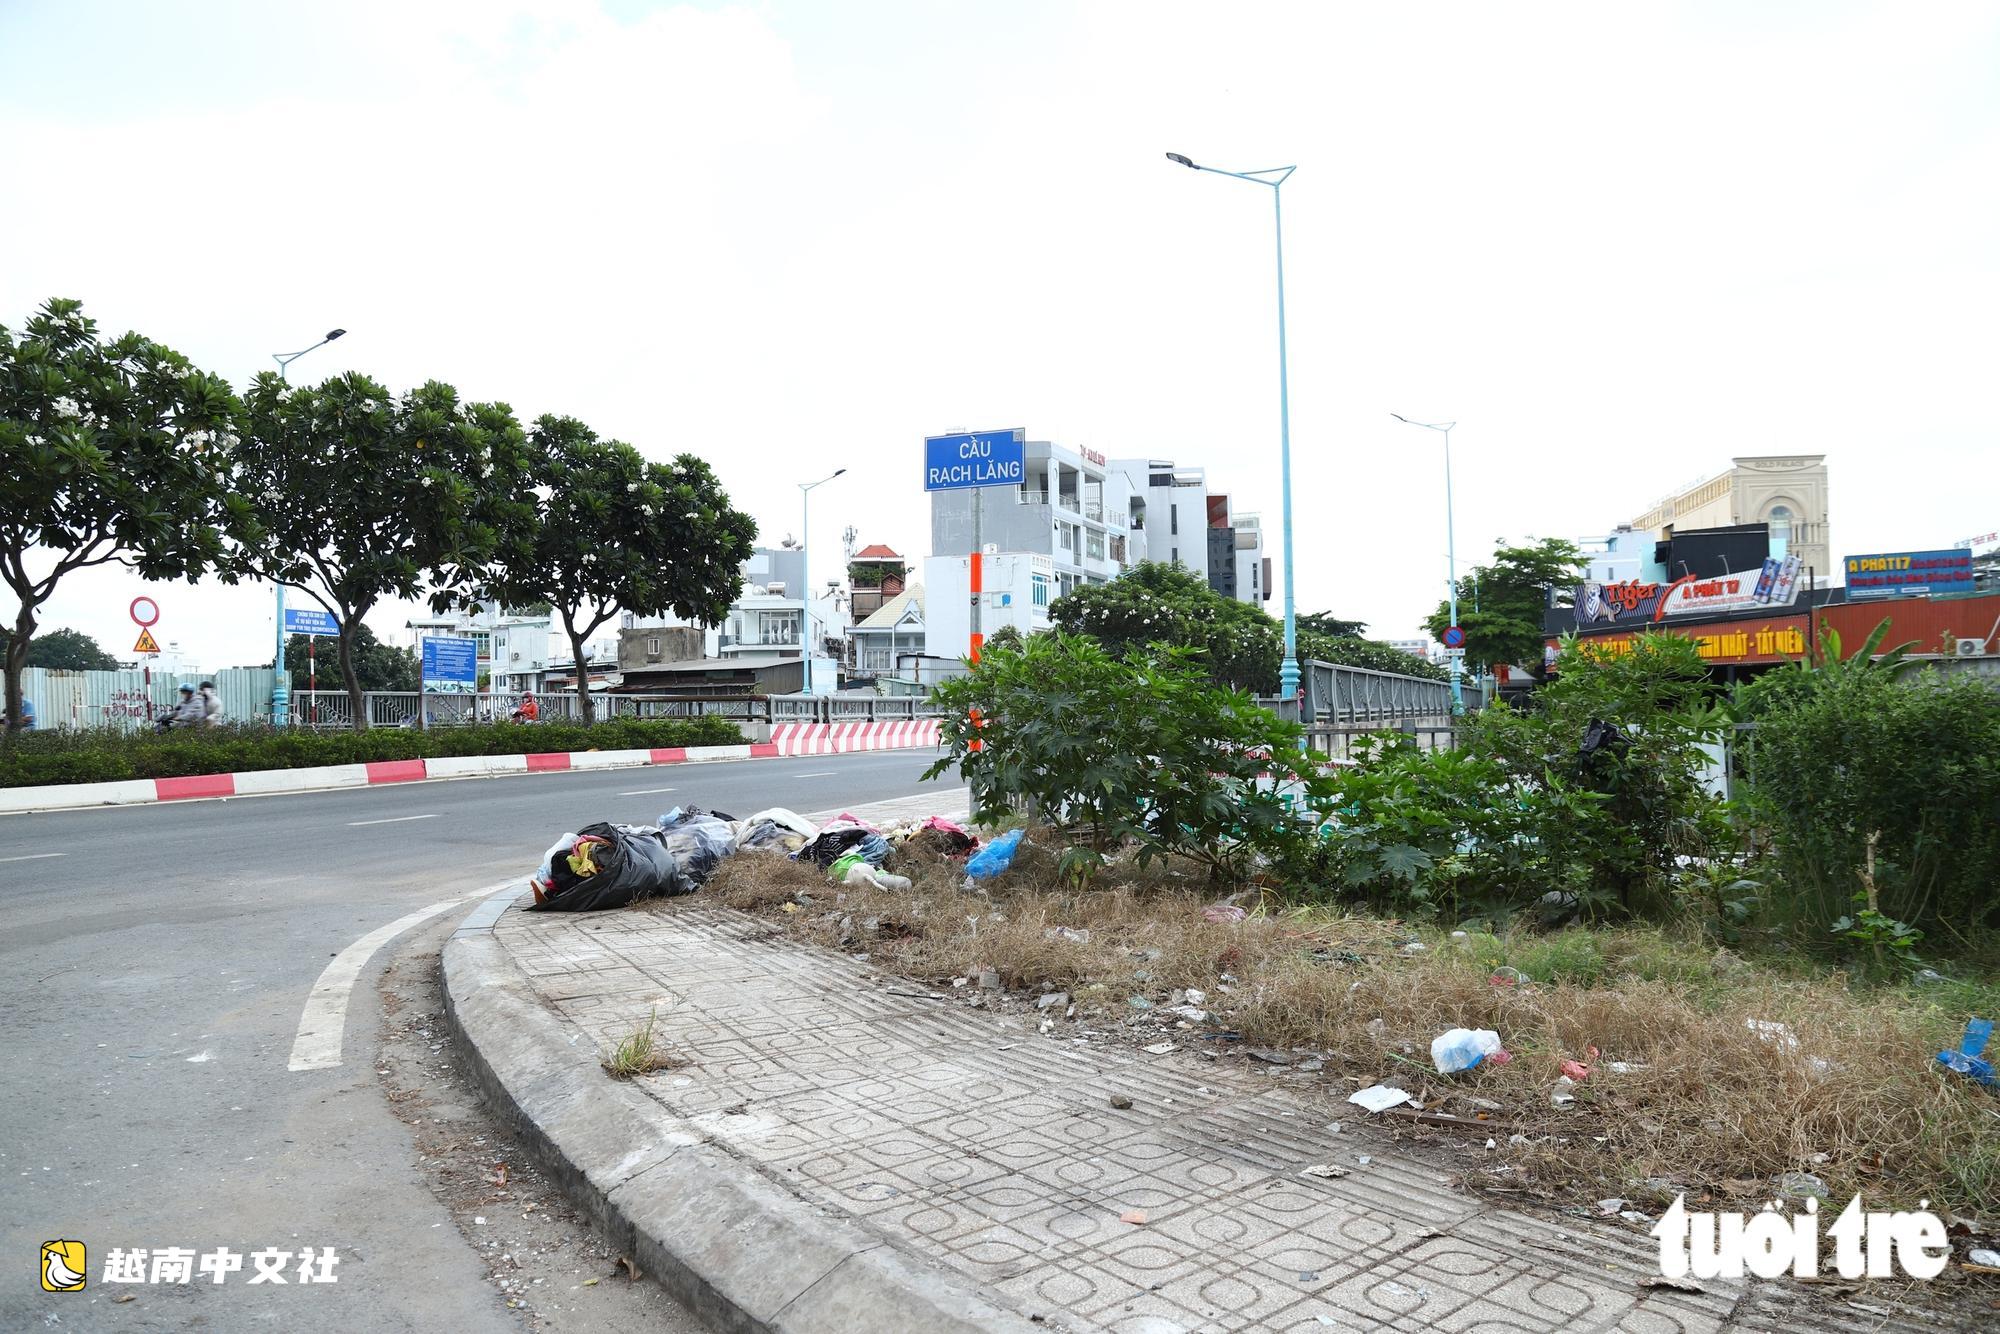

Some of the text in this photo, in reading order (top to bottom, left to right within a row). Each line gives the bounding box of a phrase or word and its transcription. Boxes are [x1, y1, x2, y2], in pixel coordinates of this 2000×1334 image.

[959, 436, 991, 459] CẦU
[929, 459, 1020, 487] RẠCH LĂNG
[1848, 560, 1858, 573] A
[1606, 579, 1658, 610] Tiger
[1682, 586, 1691, 599] A
[1721, 629, 1748, 661] NHẬT
[1755, 625, 1774, 656] TẤT
